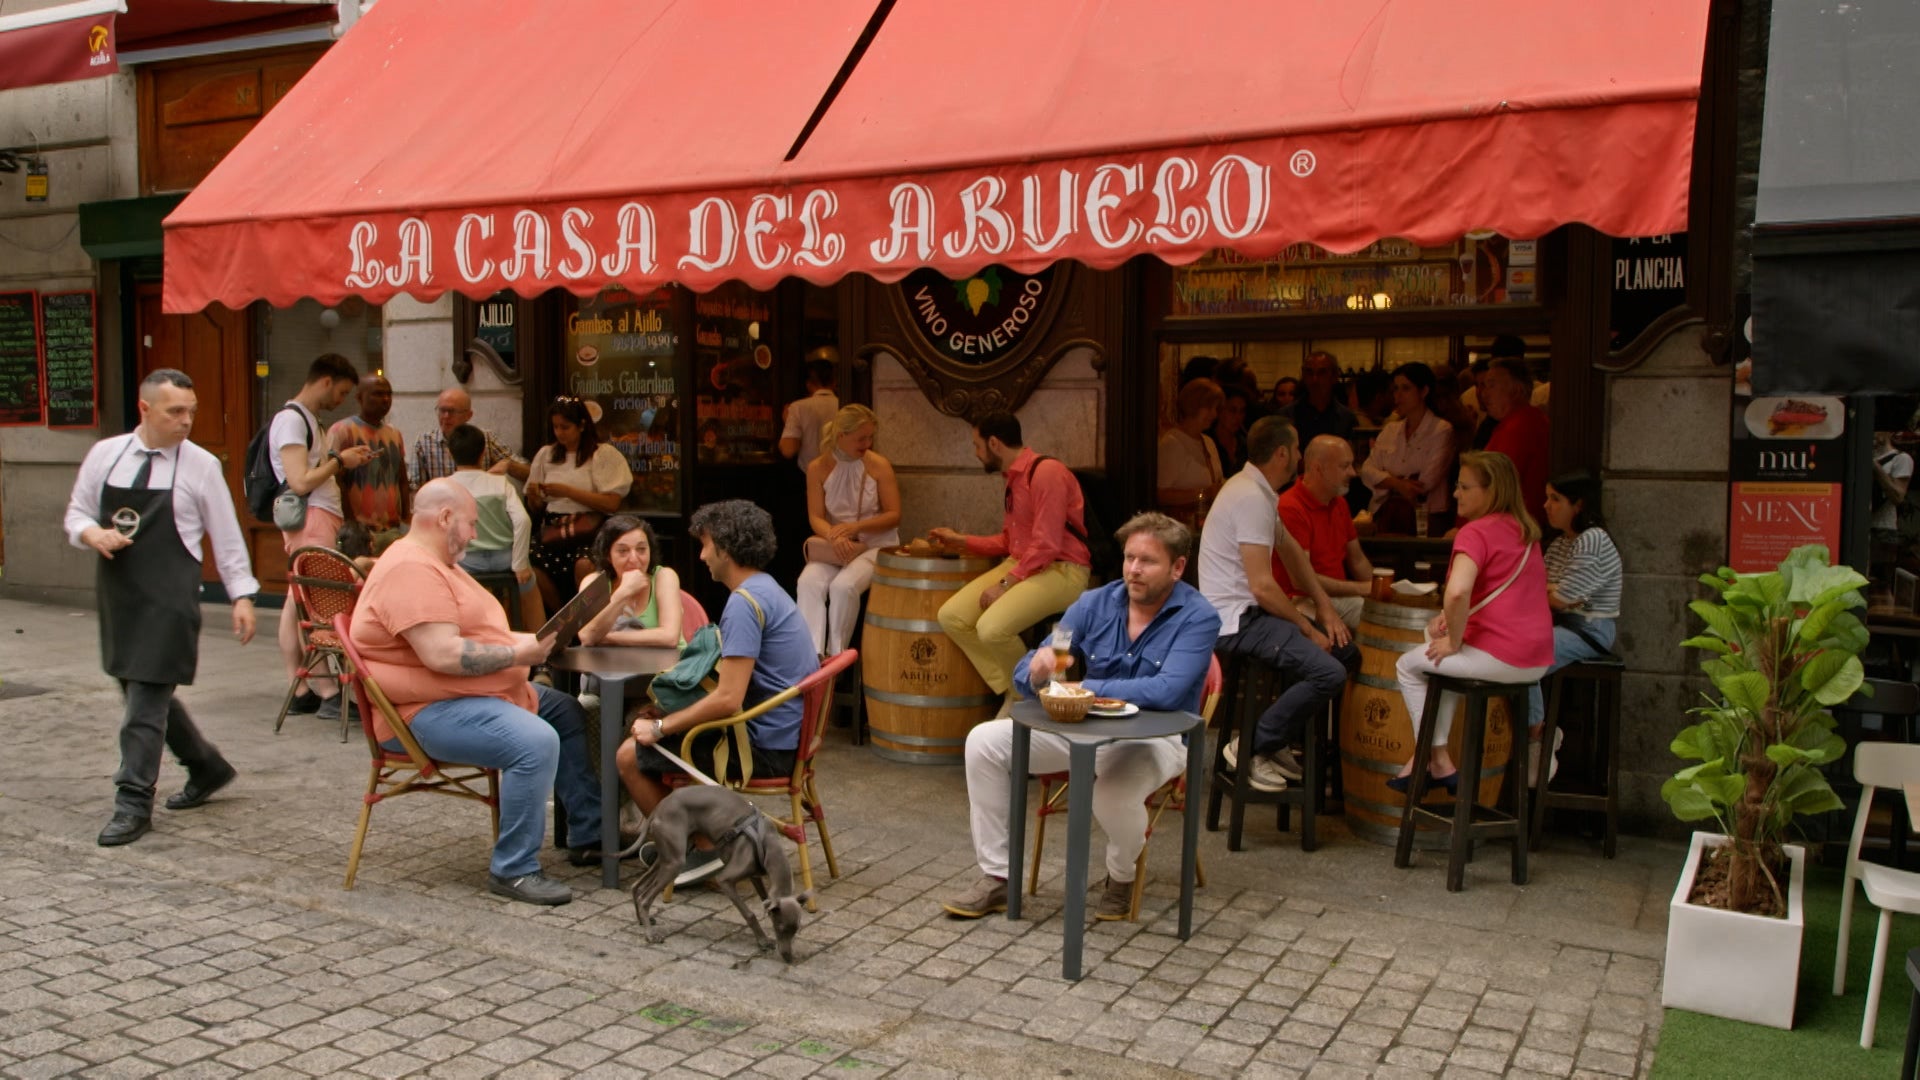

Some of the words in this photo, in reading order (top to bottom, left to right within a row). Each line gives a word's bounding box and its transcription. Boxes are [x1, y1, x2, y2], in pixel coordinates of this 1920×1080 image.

[345, 217, 433, 288] LA
[455, 203, 659, 282] CASA
[677, 189, 844, 272] DEL
[870, 155, 1270, 264] ABUELO
[1615, 257, 1685, 290] PLANCHA
[479, 303, 513, 328] AJILLO
[569, 311, 613, 336] Gambas
[618, 310, 629, 333] al
[634, 309, 662, 336] Ajillo
[914, 285, 947, 336] VINO
[949, 278, 1043, 355] GENEROSO
[570, 371, 613, 395] Gambas
[620, 370, 675, 395] Gabardina
[1741, 498, 1830, 532] MENÚ
